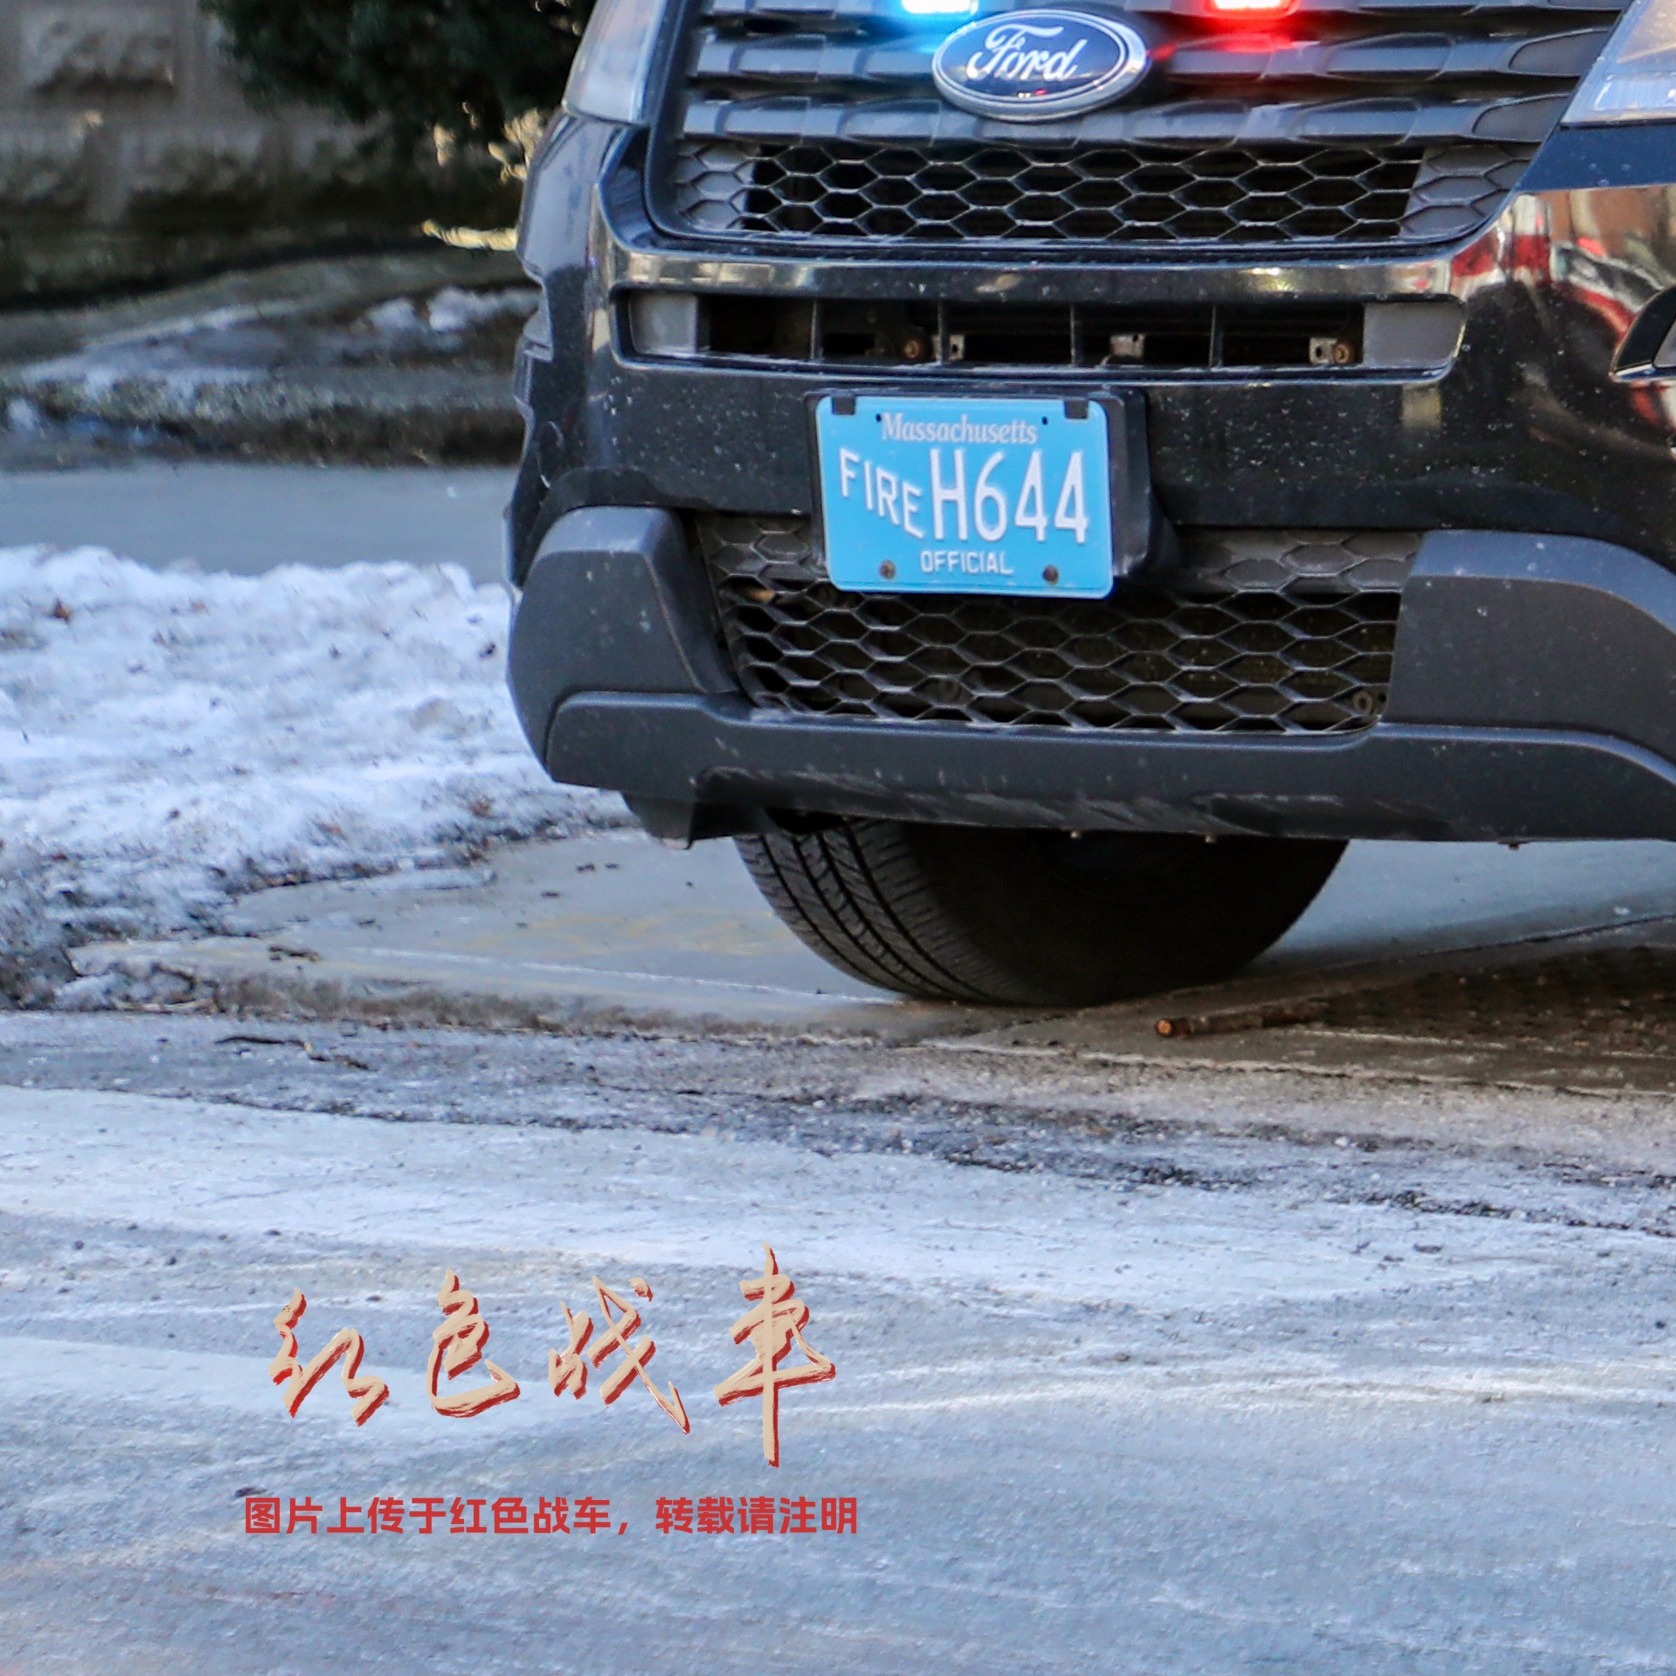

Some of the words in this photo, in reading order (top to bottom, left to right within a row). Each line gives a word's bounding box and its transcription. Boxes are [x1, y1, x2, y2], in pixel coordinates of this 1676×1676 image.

[966, 23, 1088, 82] Ford
[880, 410, 1039, 445] Massachusetts
[838, 447, 926, 541] FIRE
[928, 446, 1091, 545] H644
[919, 549, 1016, 576] OFFICIAL
